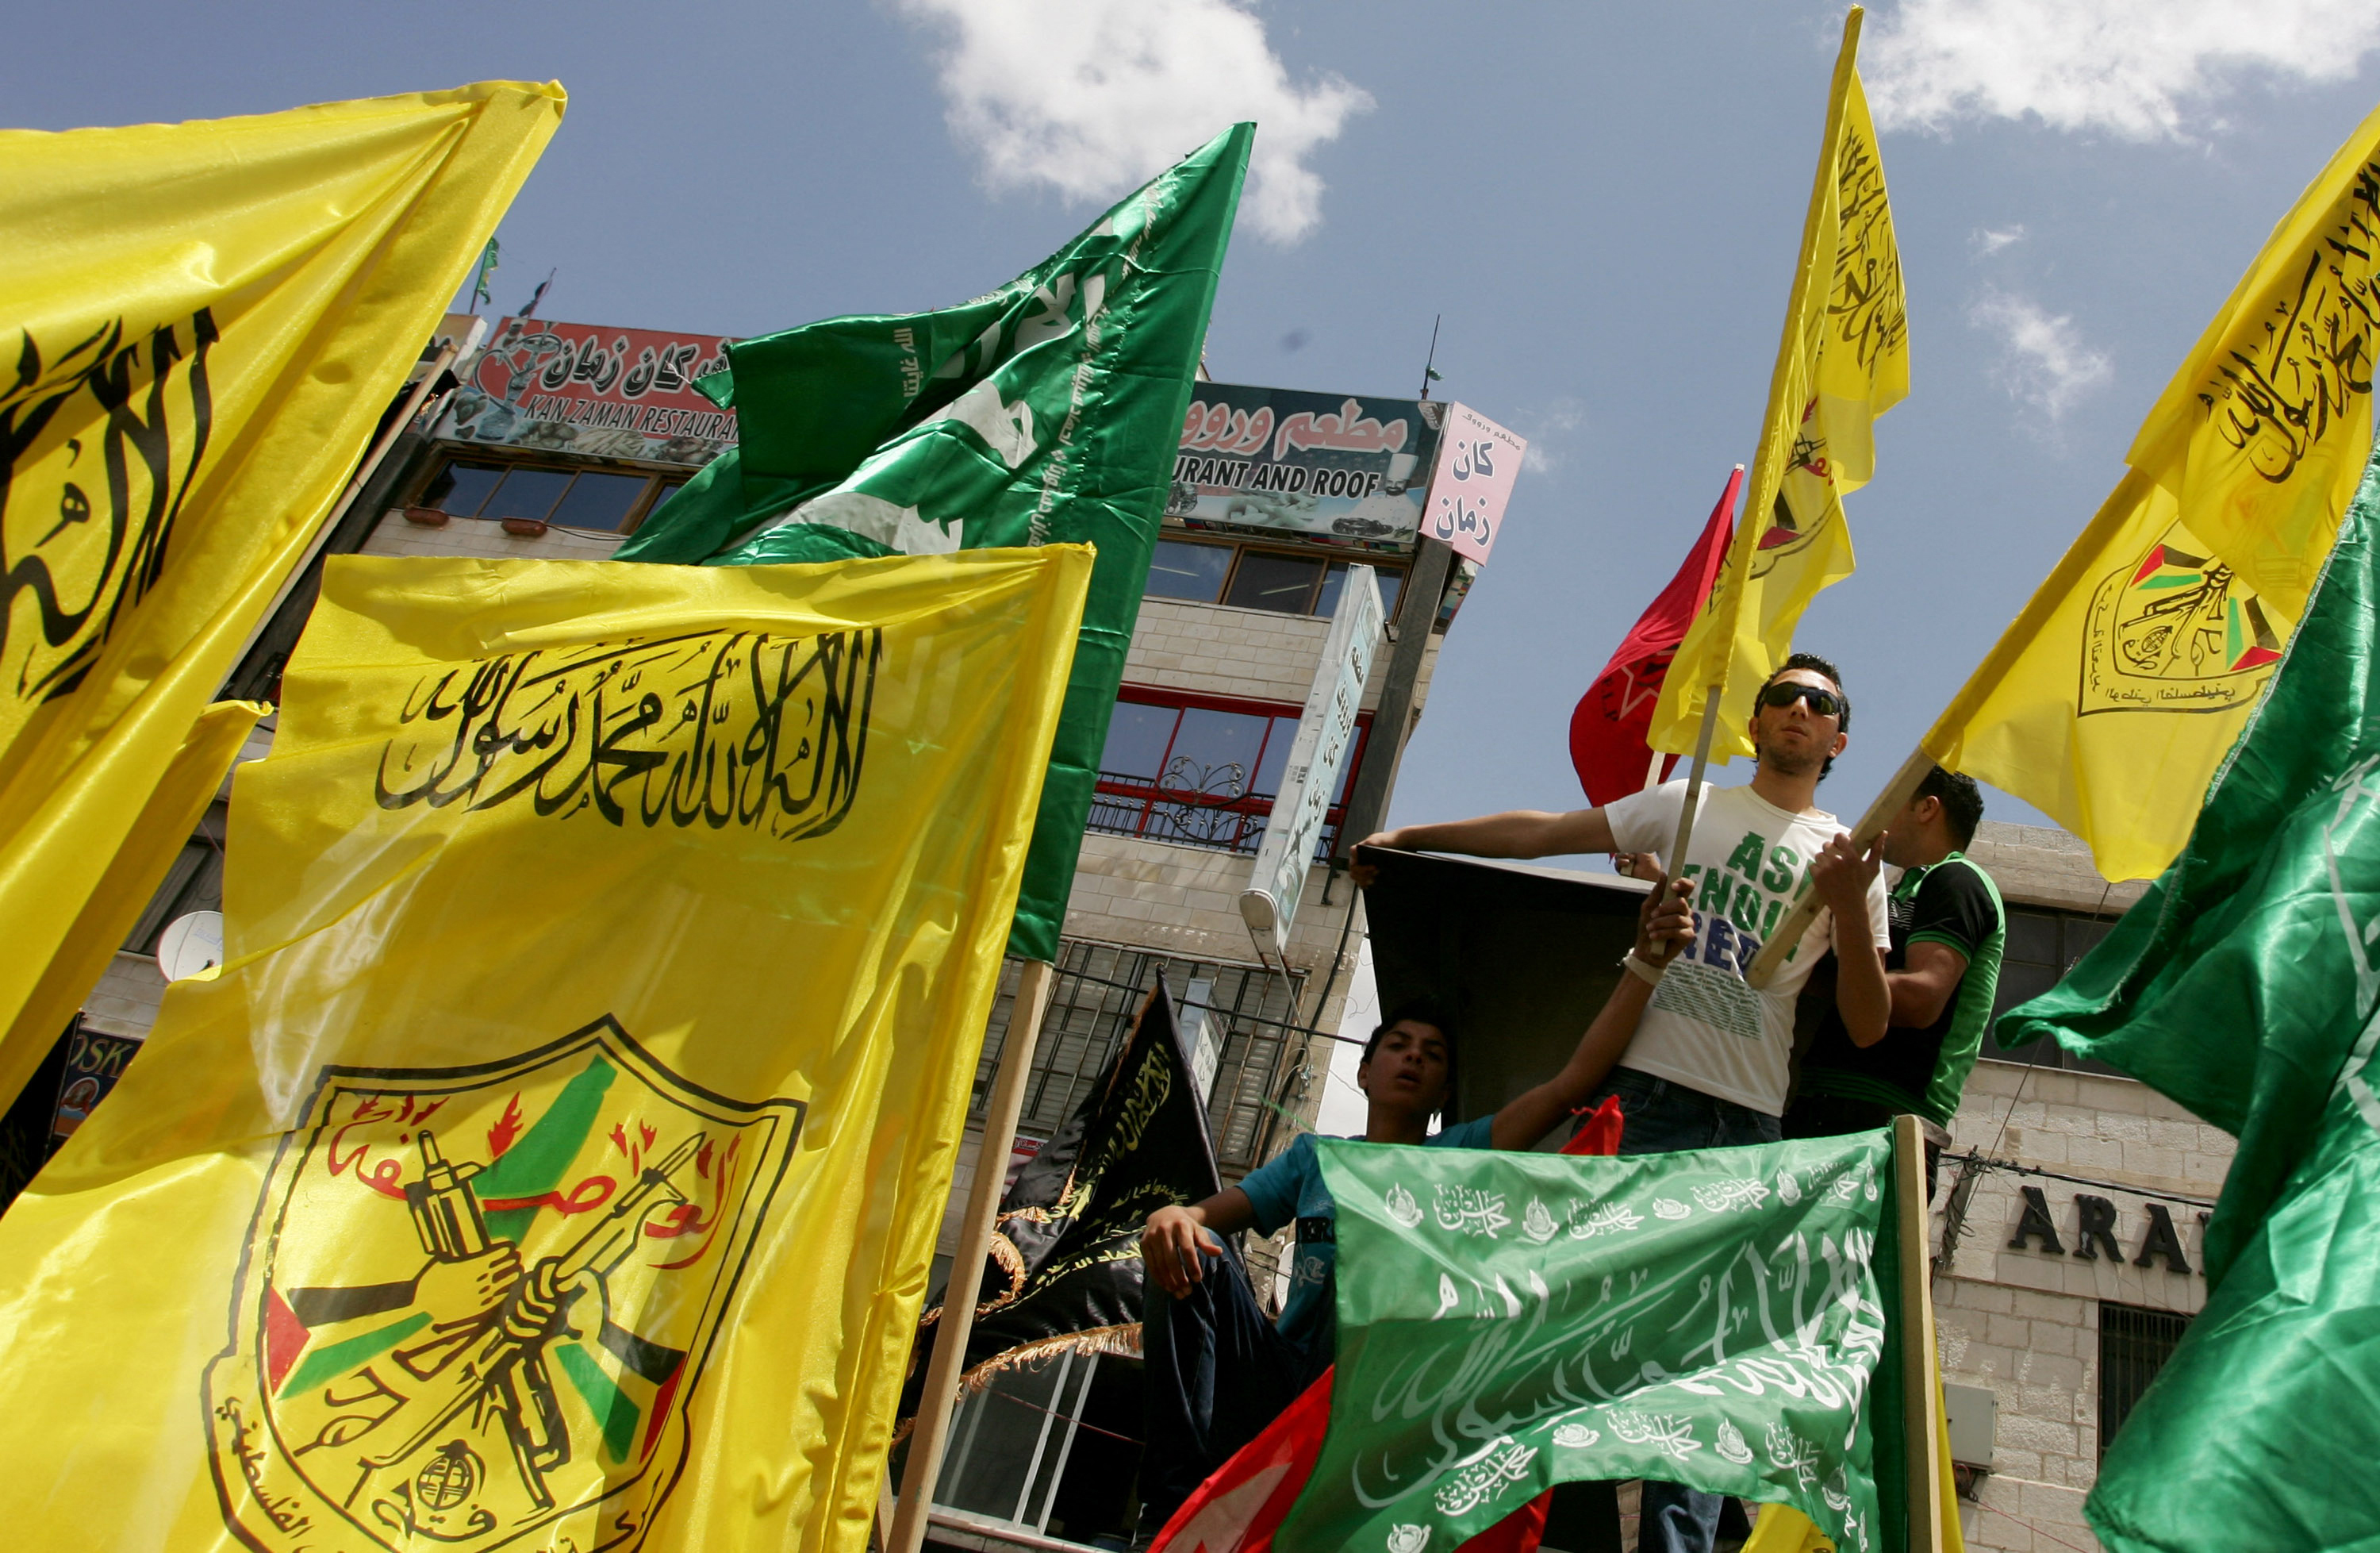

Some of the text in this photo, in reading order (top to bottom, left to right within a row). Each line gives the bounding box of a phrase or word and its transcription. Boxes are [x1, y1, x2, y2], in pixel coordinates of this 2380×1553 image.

[543, 334, 629, 396] زمان
[624, 340, 699, 397] كان
[524, 394, 566, 423] KAN
[566, 398, 643, 432] ZAMAN
[1058, 404, 1081, 446] لجهاد
[1273, 398, 1408, 462] مطعم
[1453, 440, 1494, 482] كان
[1493, 431, 1521, 451] مطعم
[1250, 464, 1307, 494] AND
[1311, 470, 1379, 498] ROOF
[1434, 494, 1491, 548] زمان
[2006, 1185, 2213, 1278] ARA
[213, 1394, 317, 1540] الفلسطيني
